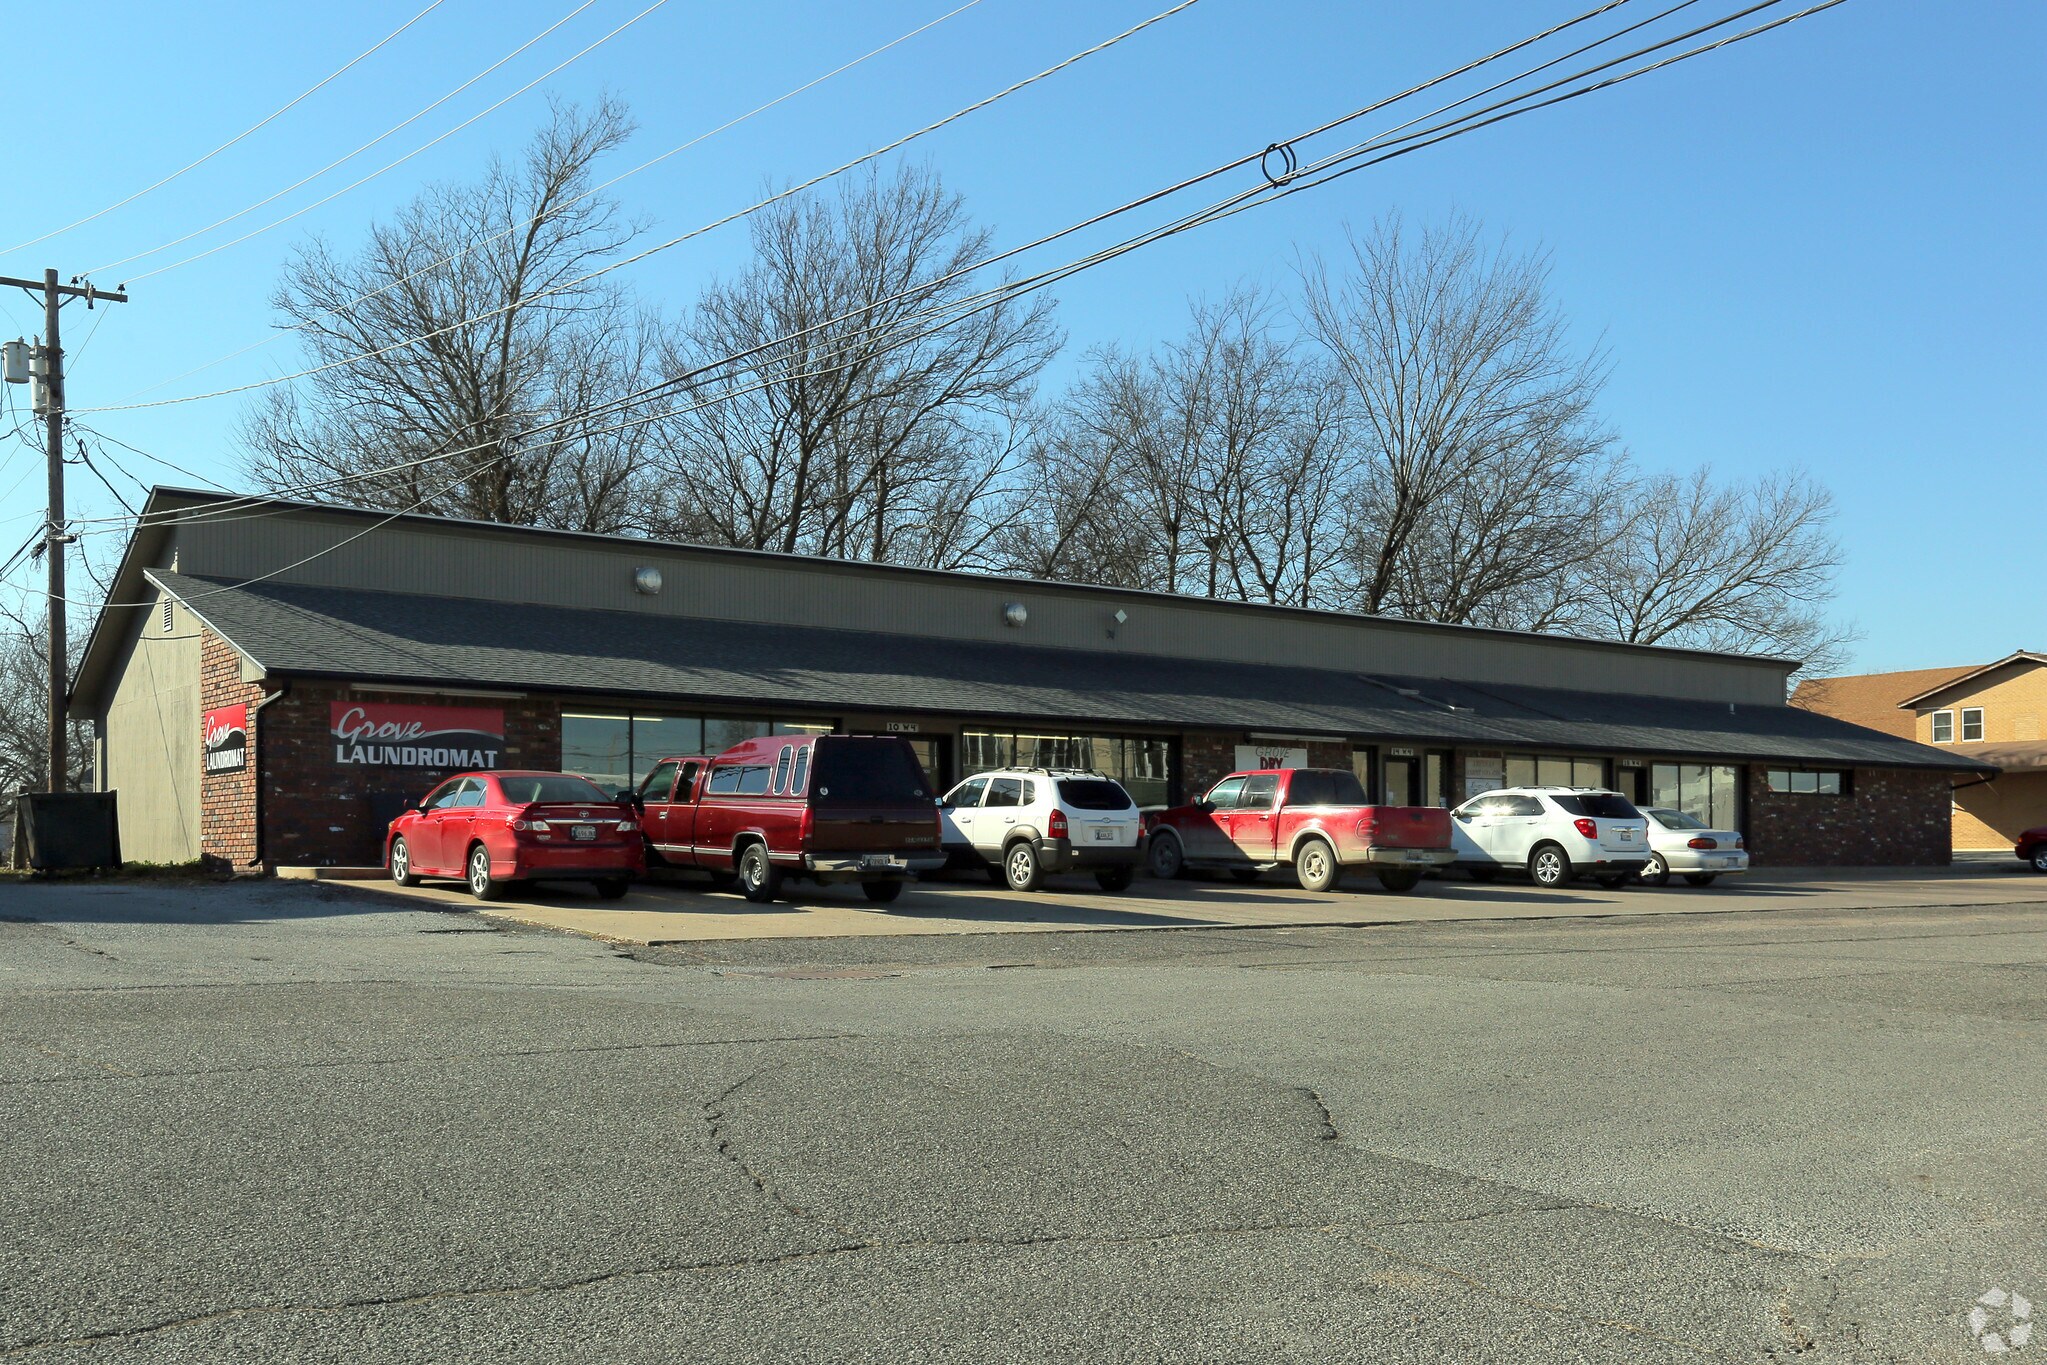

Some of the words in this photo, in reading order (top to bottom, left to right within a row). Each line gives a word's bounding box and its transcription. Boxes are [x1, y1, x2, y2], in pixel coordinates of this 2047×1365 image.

[337, 707, 426, 745] Grove
[206, 748, 245, 771] LAUNDROMAT
[336, 744, 498, 768] LAUNDROMAT
[1255, 746, 1292, 758] GROVE
[1260, 756, 1283, 770] DRY
